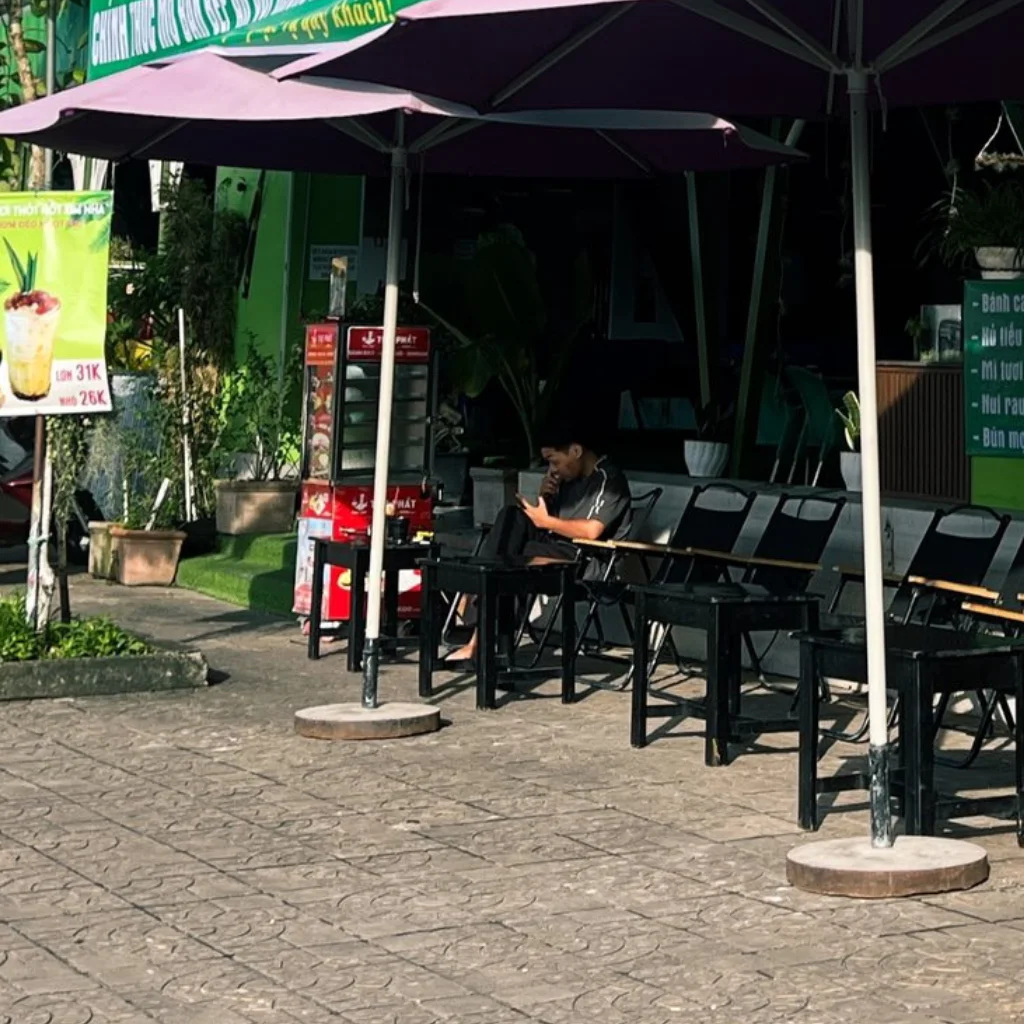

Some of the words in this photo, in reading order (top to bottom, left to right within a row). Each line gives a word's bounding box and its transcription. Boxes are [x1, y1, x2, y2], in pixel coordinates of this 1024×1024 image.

[981, 292, 1010, 313] Bánh
[75, 362, 102, 381] 31K
[79, 389, 107, 406] 26K
